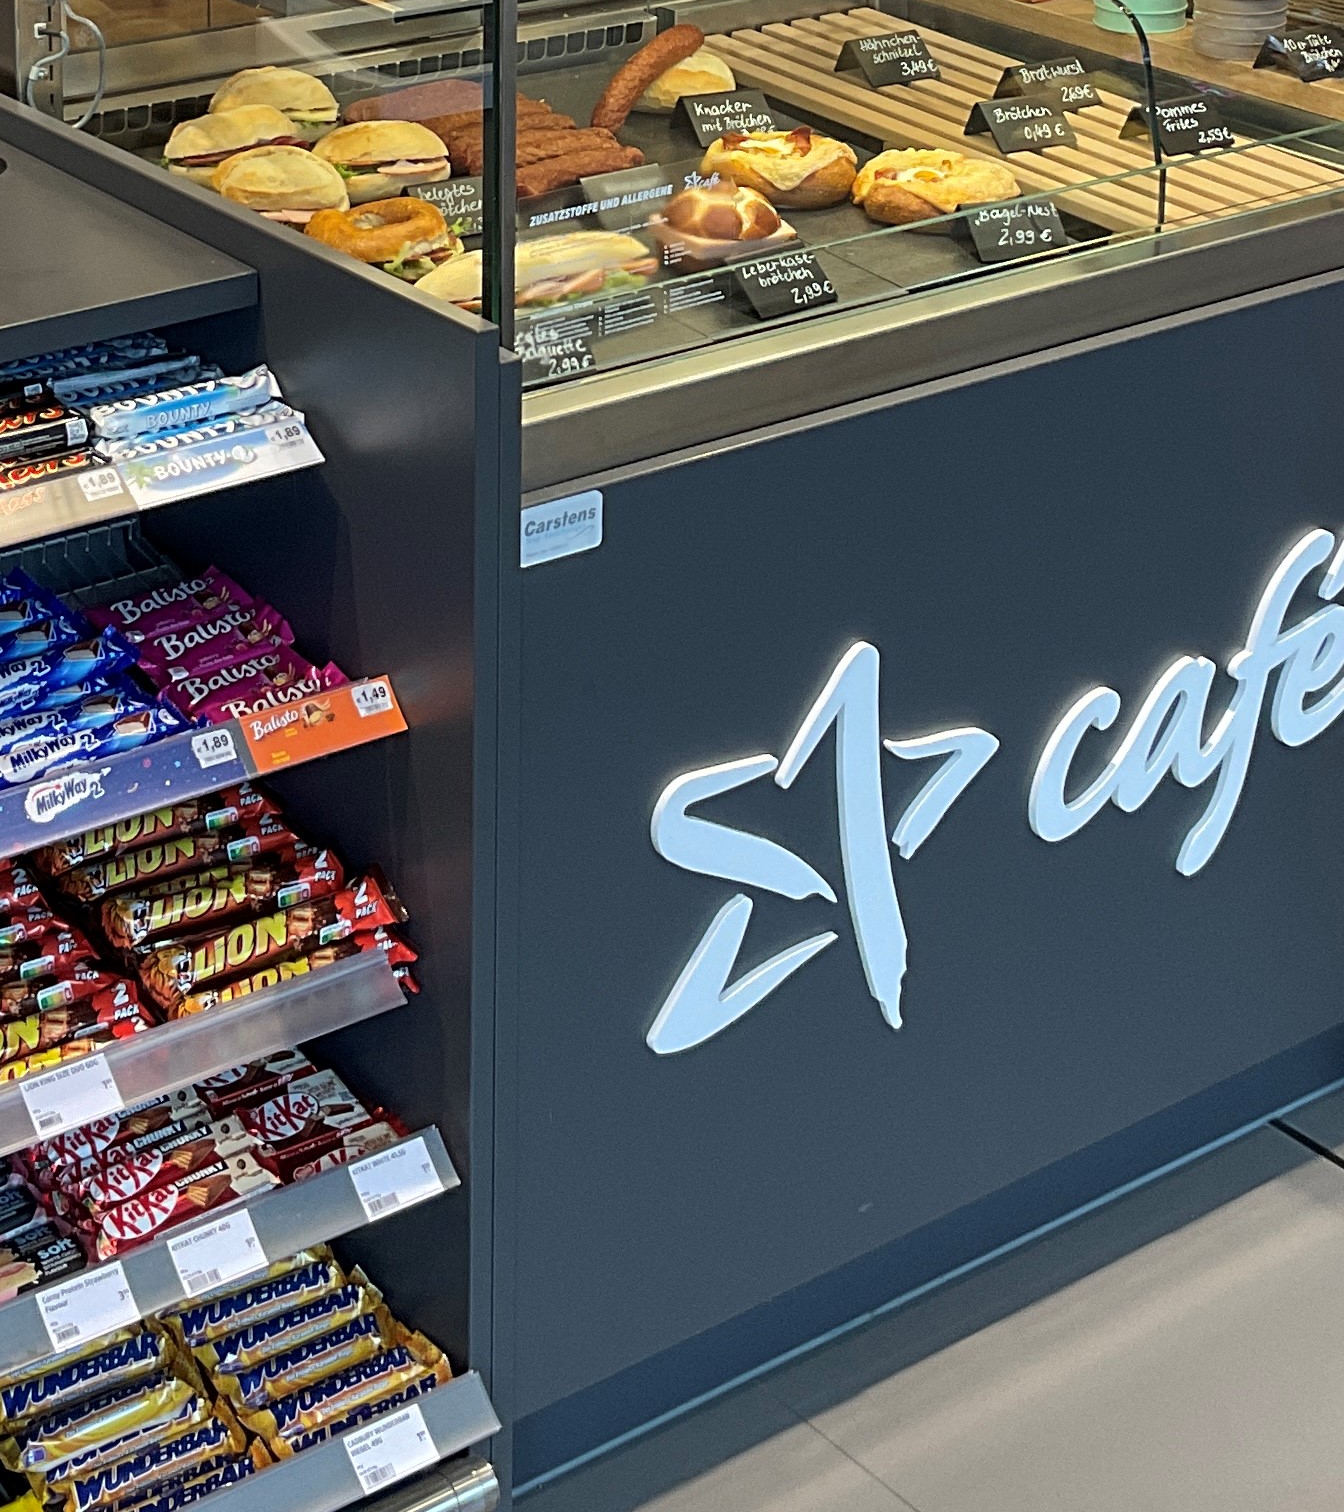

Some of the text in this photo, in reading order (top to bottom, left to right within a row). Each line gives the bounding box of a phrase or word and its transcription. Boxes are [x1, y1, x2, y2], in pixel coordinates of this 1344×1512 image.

[859, 30, 922, 51] Hähnchen-
[871, 42, 924, 65] schnitzel
[900, 58, 938, 76] 3,49€
[1018, 60, 1087, 85] Bratwurst
[693, 101, 753, 118] Knacker
[993, 103, 1053, 124] Brötchen
[1154, 101, 1207, 119] Pommes
[701, 114, 775, 133] mit Brötchen
[1197, 126, 1234, 144] 2,59€
[529, 184, 673, 228] ZUSATZSTOFFE UND ALLERGENE
[997, 227, 1038, 246] 2,99
[758, 267, 814, 287] brötchen
[791, 280, 835, 304] 2,99€
[145, 400, 213, 428] BOUNTY
[524, 504, 597, 539] Carstens
[110, 576, 205, 625] Balisto
[9, 732, 78, 773] MilkyWay
[191, 909, 290, 981] LION
[254, 1092, 318, 1142] KitKat
[174, 1162, 227, 1189] CHUNKY
[105, 1185, 176, 1238] KitKat
[181, 1261, 329, 1338] WUNDERBAR
[0, 1333, 158, 1420] WUNDERBAR
